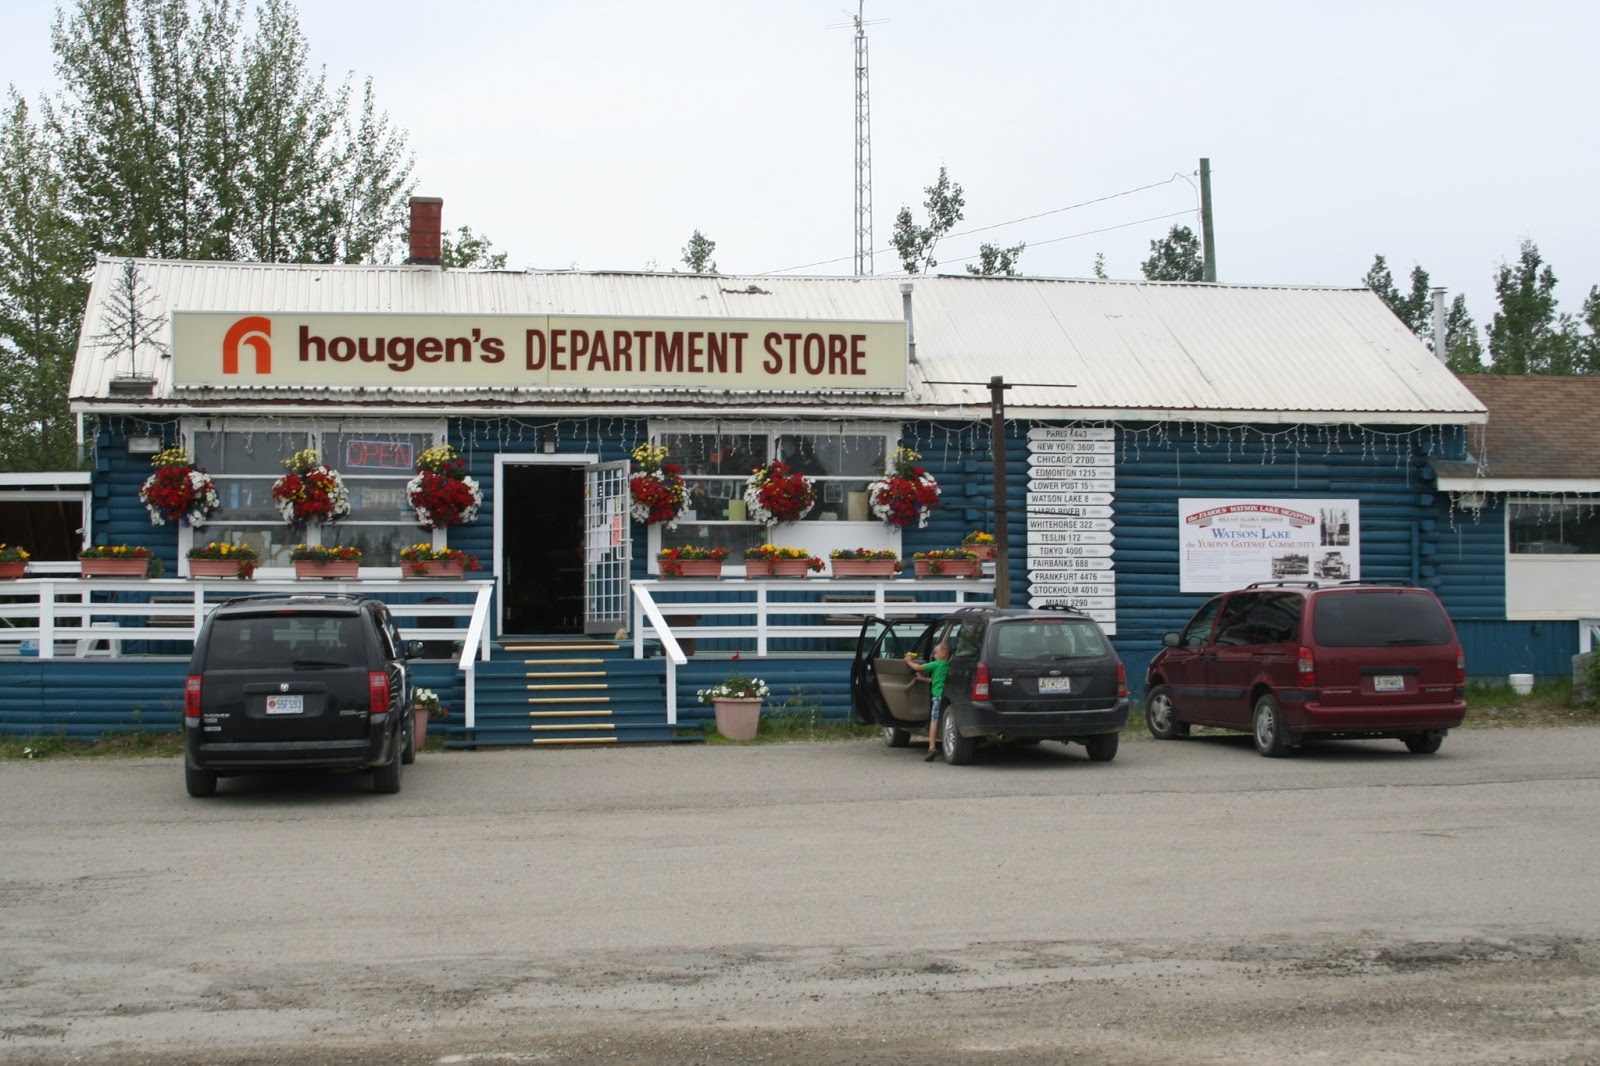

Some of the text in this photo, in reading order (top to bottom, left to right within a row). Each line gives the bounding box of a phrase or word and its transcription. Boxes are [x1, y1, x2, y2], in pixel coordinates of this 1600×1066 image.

[299, 325, 867, 375] hougen's DEPARTMENT STORE
[1046, 430, 1068, 438] PARIS
[1036, 443, 1054, 451] NEW
[1056, 443, 1075, 451] YORK
[1077, 443, 1096, 451] 3600
[348, 442, 411, 467] OPEN
[1036, 455, 1073, 464] CHICAGO
[1075, 455, 1096, 464] 2700
[1035, 469, 1077, 477] EDMONTON
[1079, 469, 1097, 477] 1215
[1033, 482, 1059, 490] LOWER
[1060, 482, 1079, 490] POST
[1031, 495, 1062, 503] WATSON
[1064, 495, 1083, 503] LAKE
[1084, 495, 1089, 503] 8
[1081, 508, 1087, 516] 8
[1199, 507, 1227, 519] FAMOUS
[1260, 505, 1281, 514] LAKE
[1030, 521, 1078, 529] WHITEHORSE
[1080, 521, 1093, 529] 322
[1041, 534, 1066, 542] TESLIN
[1068, 534, 1081, 542] 172
[1040, 547, 1063, 555] TOKYO
[1065, 547, 1083, 555] 4000
[1035, 573, 1078, 581] FRANKFURT
[1080, 573, 1098, 581] 4476
[1033, 586, 1079, 594] STOCKHOLM
[1080, 586, 1099, 594] 4010
[1046, 599, 1068, 607] MIAMI
[1070, 599, 1088, 607] 3290
